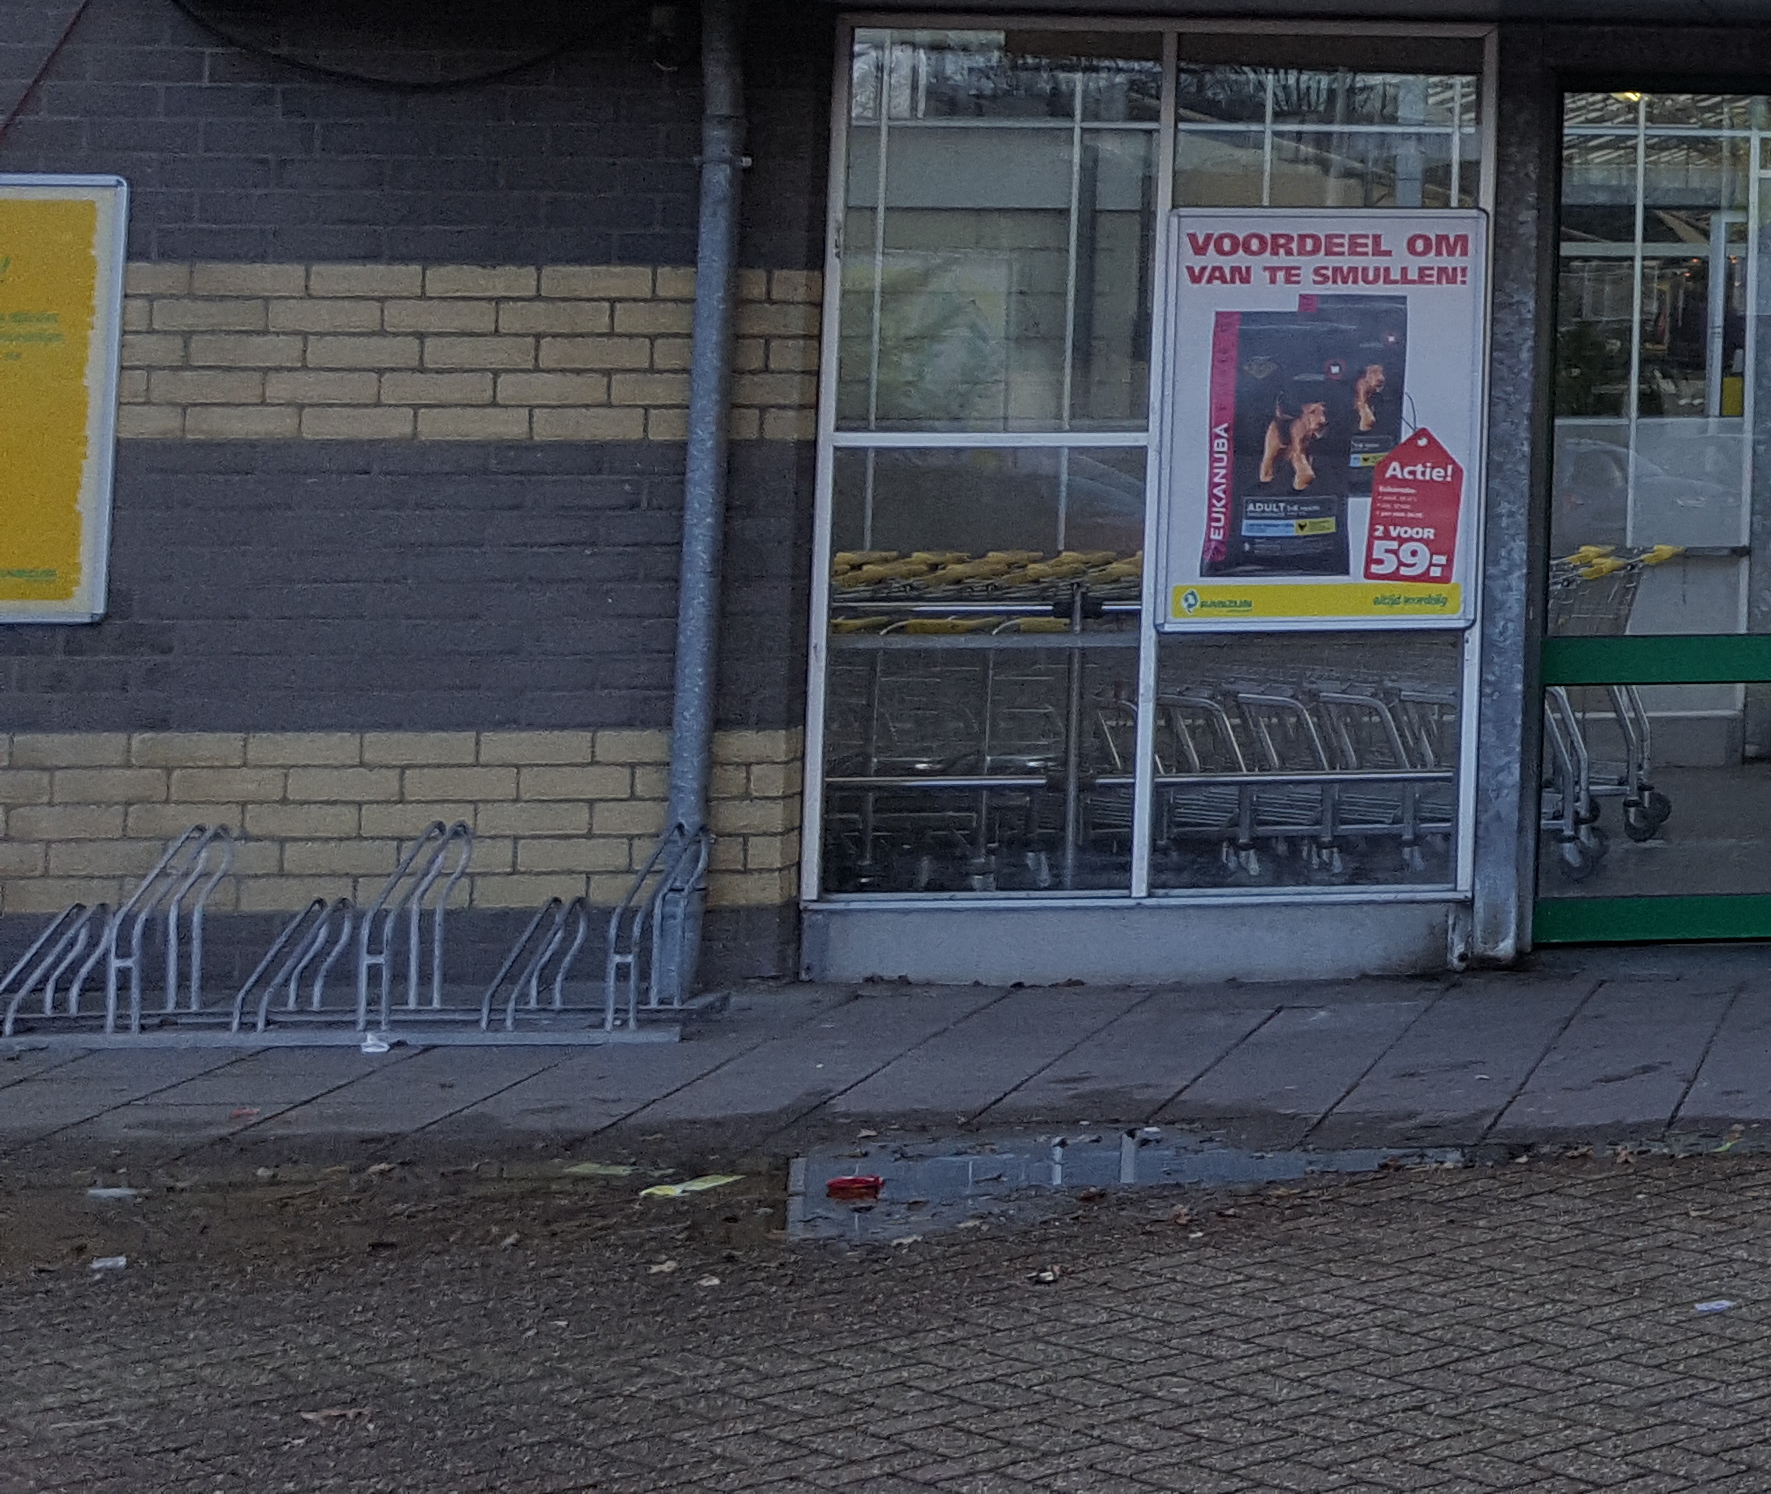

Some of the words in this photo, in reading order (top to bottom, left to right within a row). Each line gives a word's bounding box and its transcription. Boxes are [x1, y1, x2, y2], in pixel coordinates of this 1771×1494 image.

[1186, 232, 1393, 257] VOORDEEL
[1405, 233, 1469, 257] OM
[1185, 265, 1251, 285] VAN
[1263, 265, 1302, 285] TE
[1312, 266, 1468, 285] SMULLEN!
[1210, 422, 1229, 541] EUKANUBA
[1385, 462, 1453, 482] Actie!
[1246, 502, 1286, 512] ADULT
[1374, 525, 1384, 537] 2
[1389, 525, 1435, 539] VOOR
